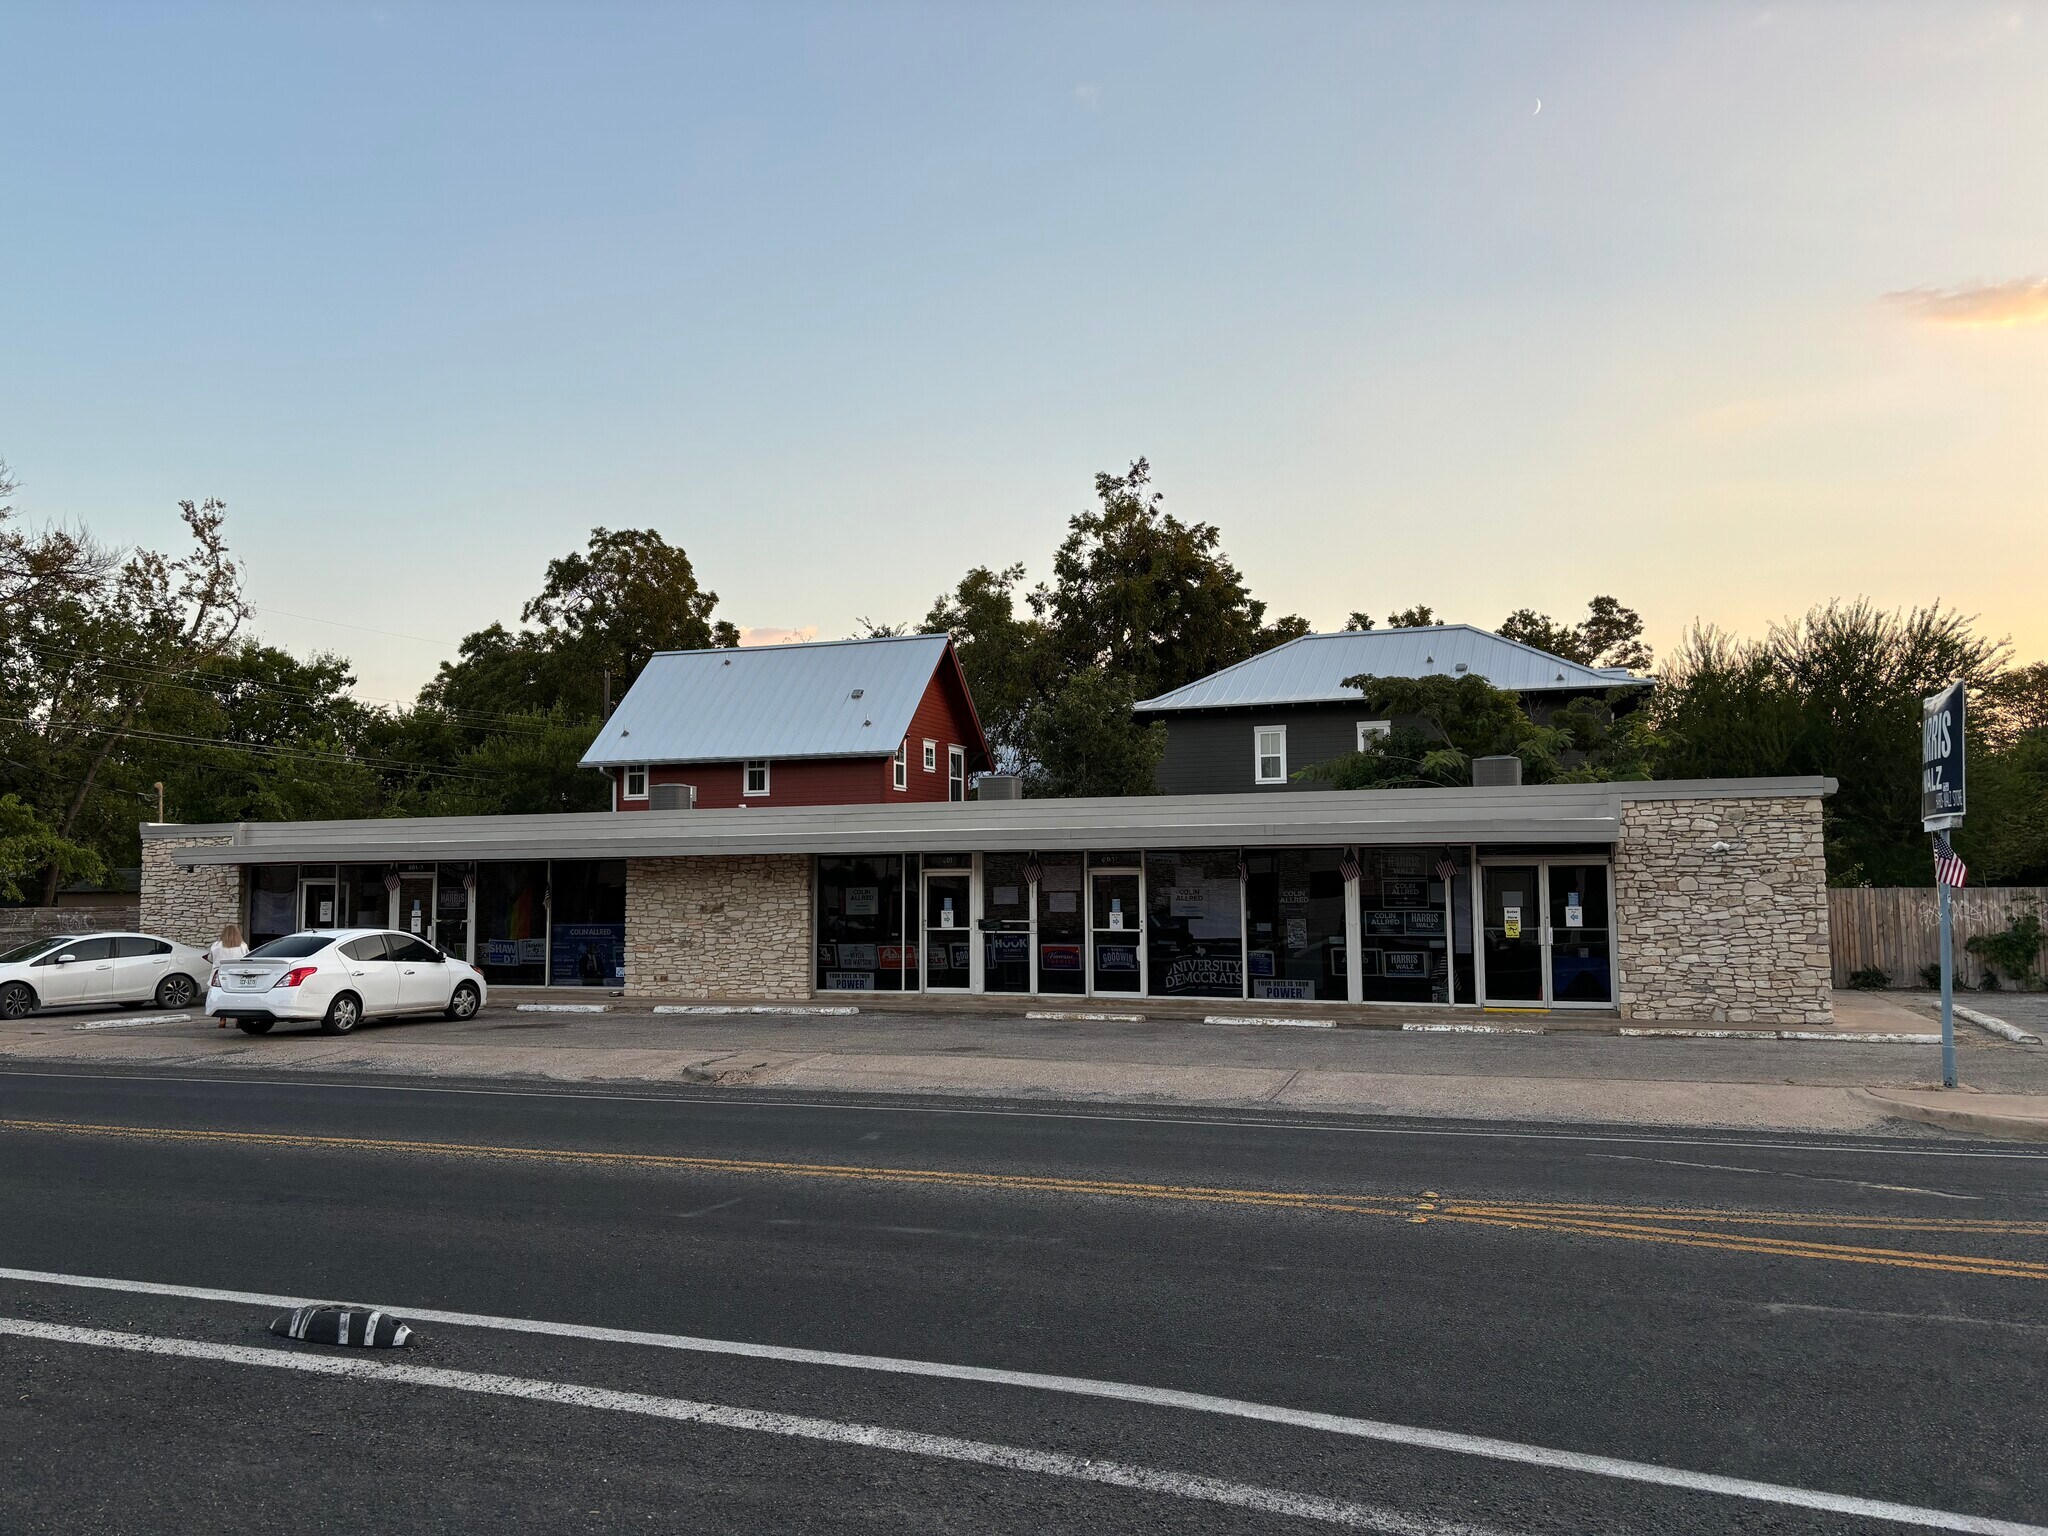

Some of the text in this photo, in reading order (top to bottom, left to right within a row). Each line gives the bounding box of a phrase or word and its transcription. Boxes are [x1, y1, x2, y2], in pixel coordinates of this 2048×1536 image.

[1388, 855, 1420, 867] HARRIS
[1393, 867, 1417, 875] WALZ
[440, 893, 465, 904] HARRIS
[1411, 913, 1439, 923] HARRIS
[490, 944, 516, 954] SHAW
[503, 955, 517, 964] D7
[1102, 952, 1134, 963] GOODWIN
[1391, 954, 1418, 965] HARRIS
[1165, 971, 1243, 988] DEMOCRATS
